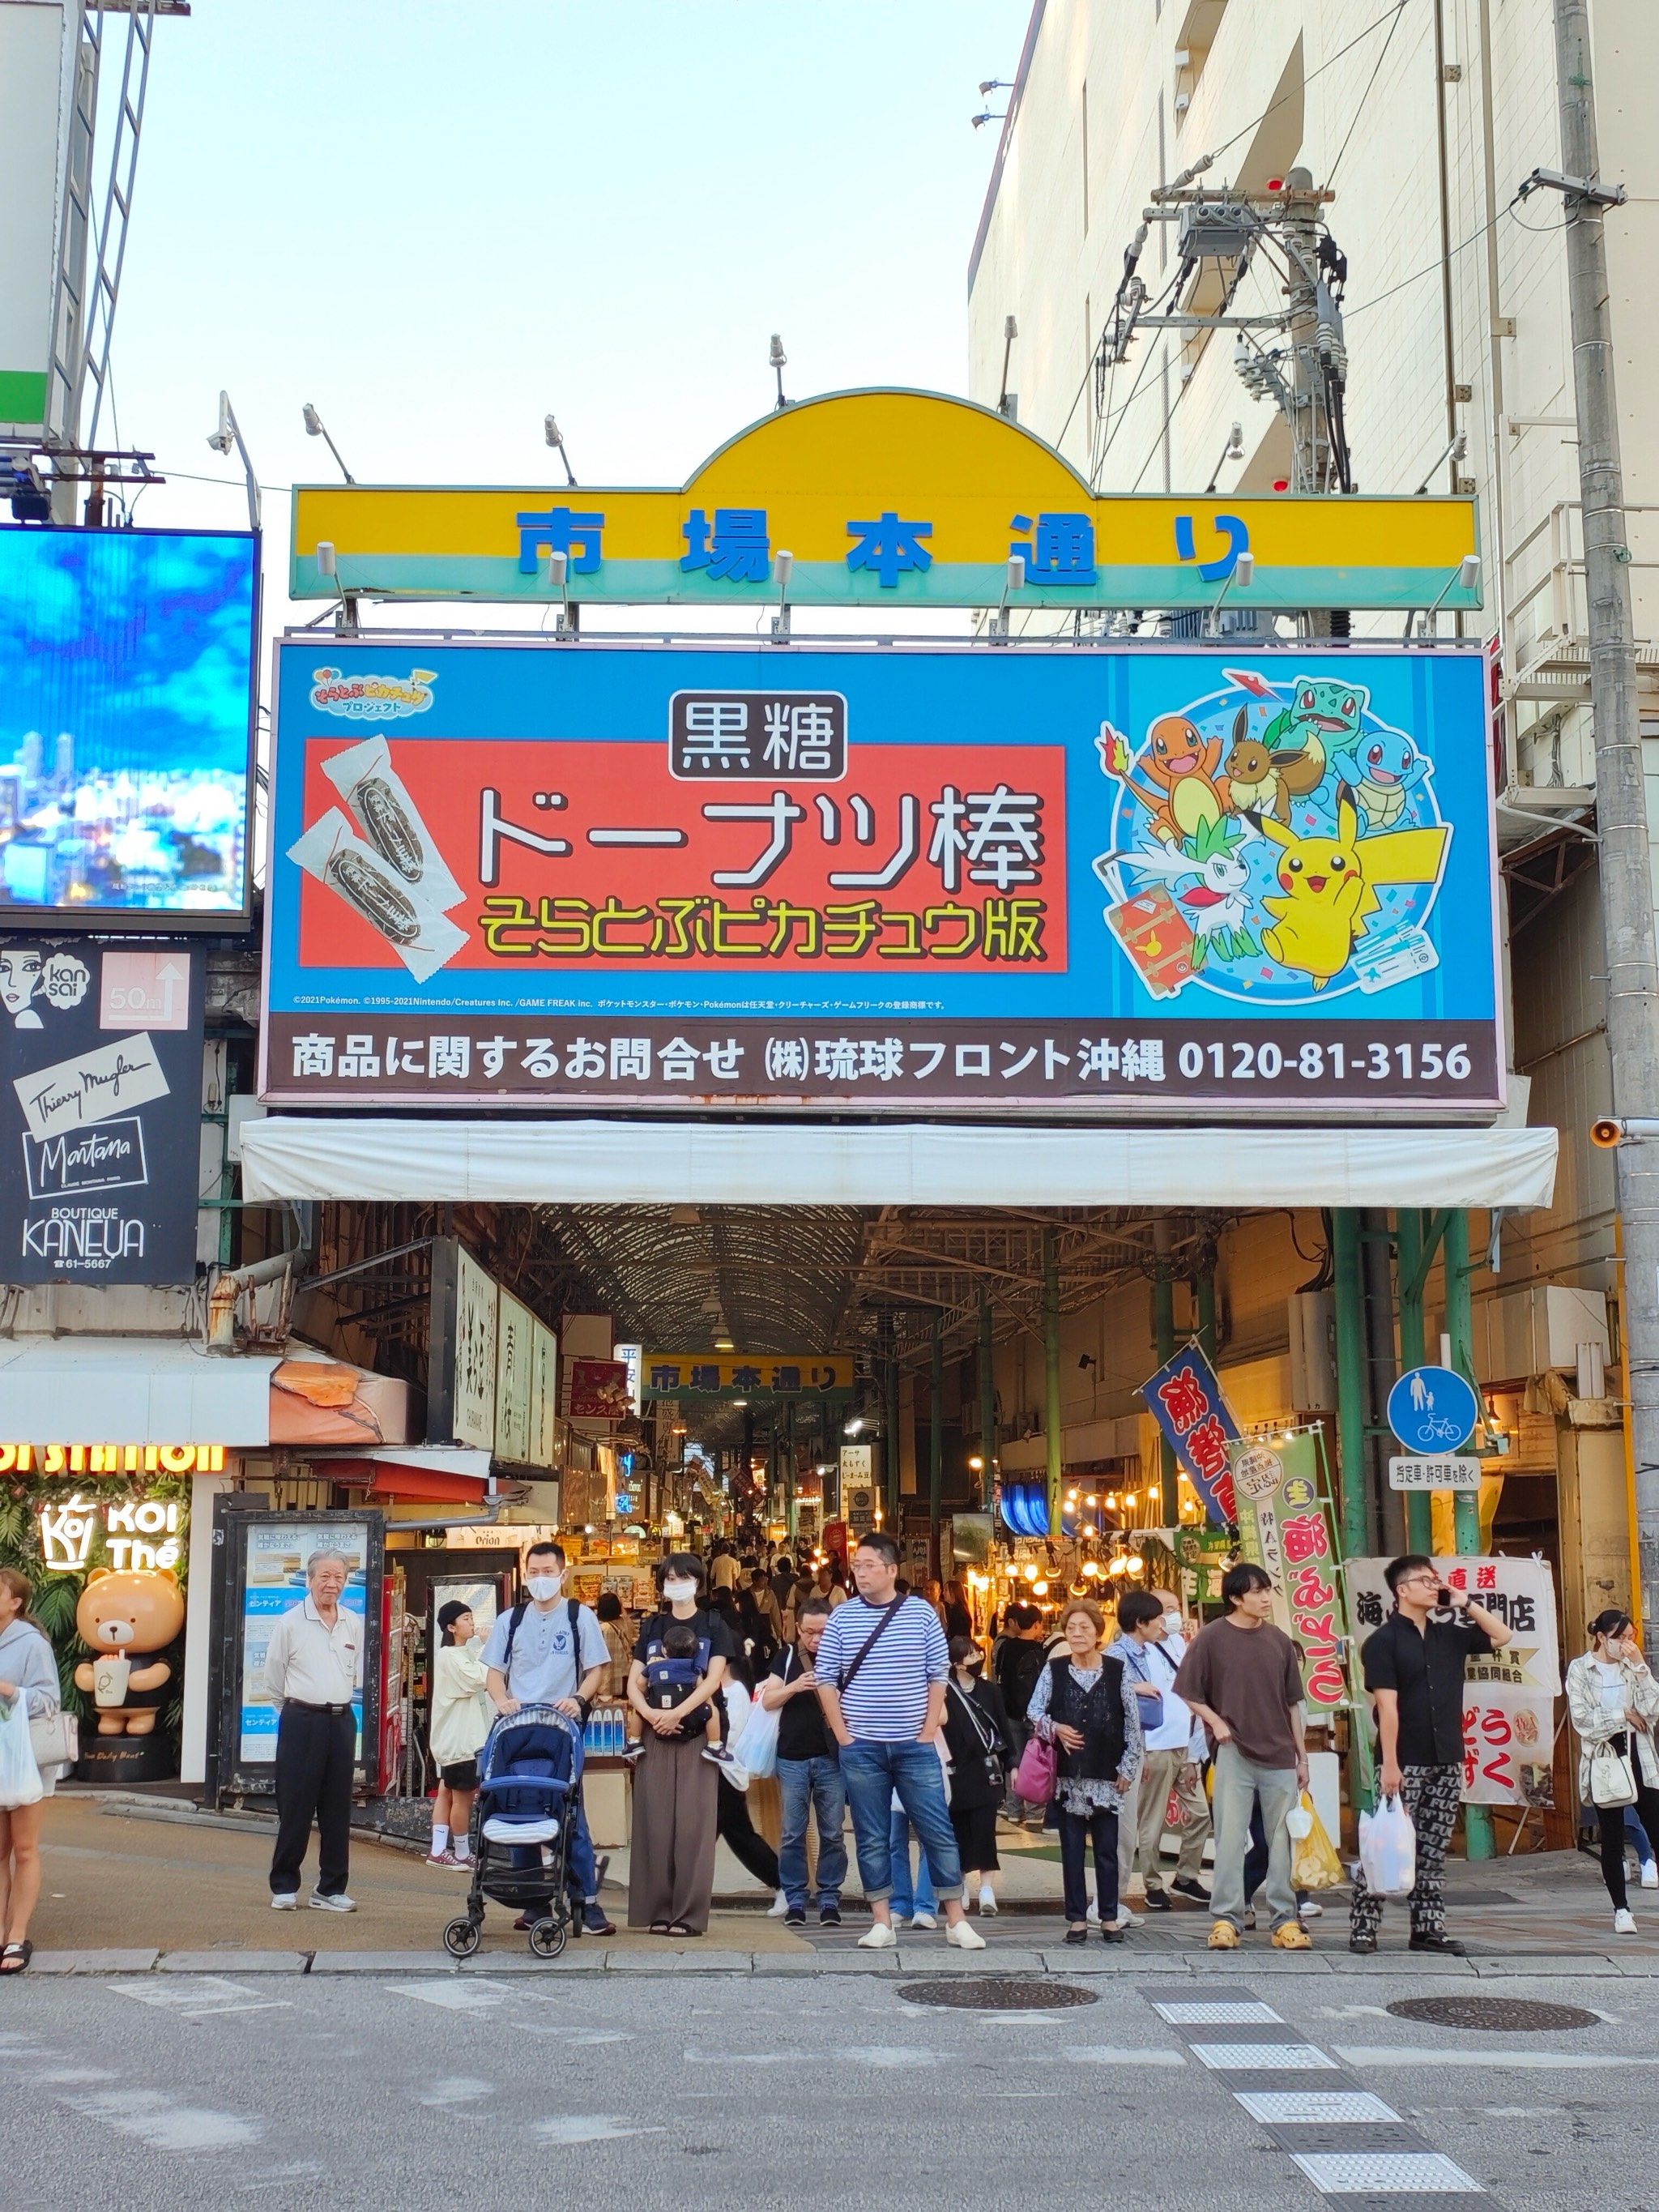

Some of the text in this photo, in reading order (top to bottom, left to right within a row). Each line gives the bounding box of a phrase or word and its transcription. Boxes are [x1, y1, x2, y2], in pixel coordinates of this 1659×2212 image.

[516, 507, 1250, 588] 市場本通り
[342, 701, 401, 712] プロジェクト
[682, 702, 834, 771] 黒糖
[480, 784, 1043, 892] ドーナツ棒
[480, 894, 1045, 961] そらとぶピカチュウ版
[49, 964, 87, 983] kan
[48, 982, 78, 997] sai
[497, 998, 513, 1007] Inc.
[547, 998, 576, 1008] FREAK
[292, 1033, 745, 1081] 商品に関するお問合せ
[1179, 1042, 1472, 1081] 0120-81-3156
[29, 1054, 152, 1123] Thierry Mugler
[41, 1134, 131, 1188] Montana
[51, 1207, 118, 1219] BOUTIQUE
[650, 1364, 836, 1393] 市場本通り
[108, 1502, 177, 1533] KOI
[105, 1538, 180, 1570] Thé
[1465, 1666, 1523, 1684] 業協同組合
